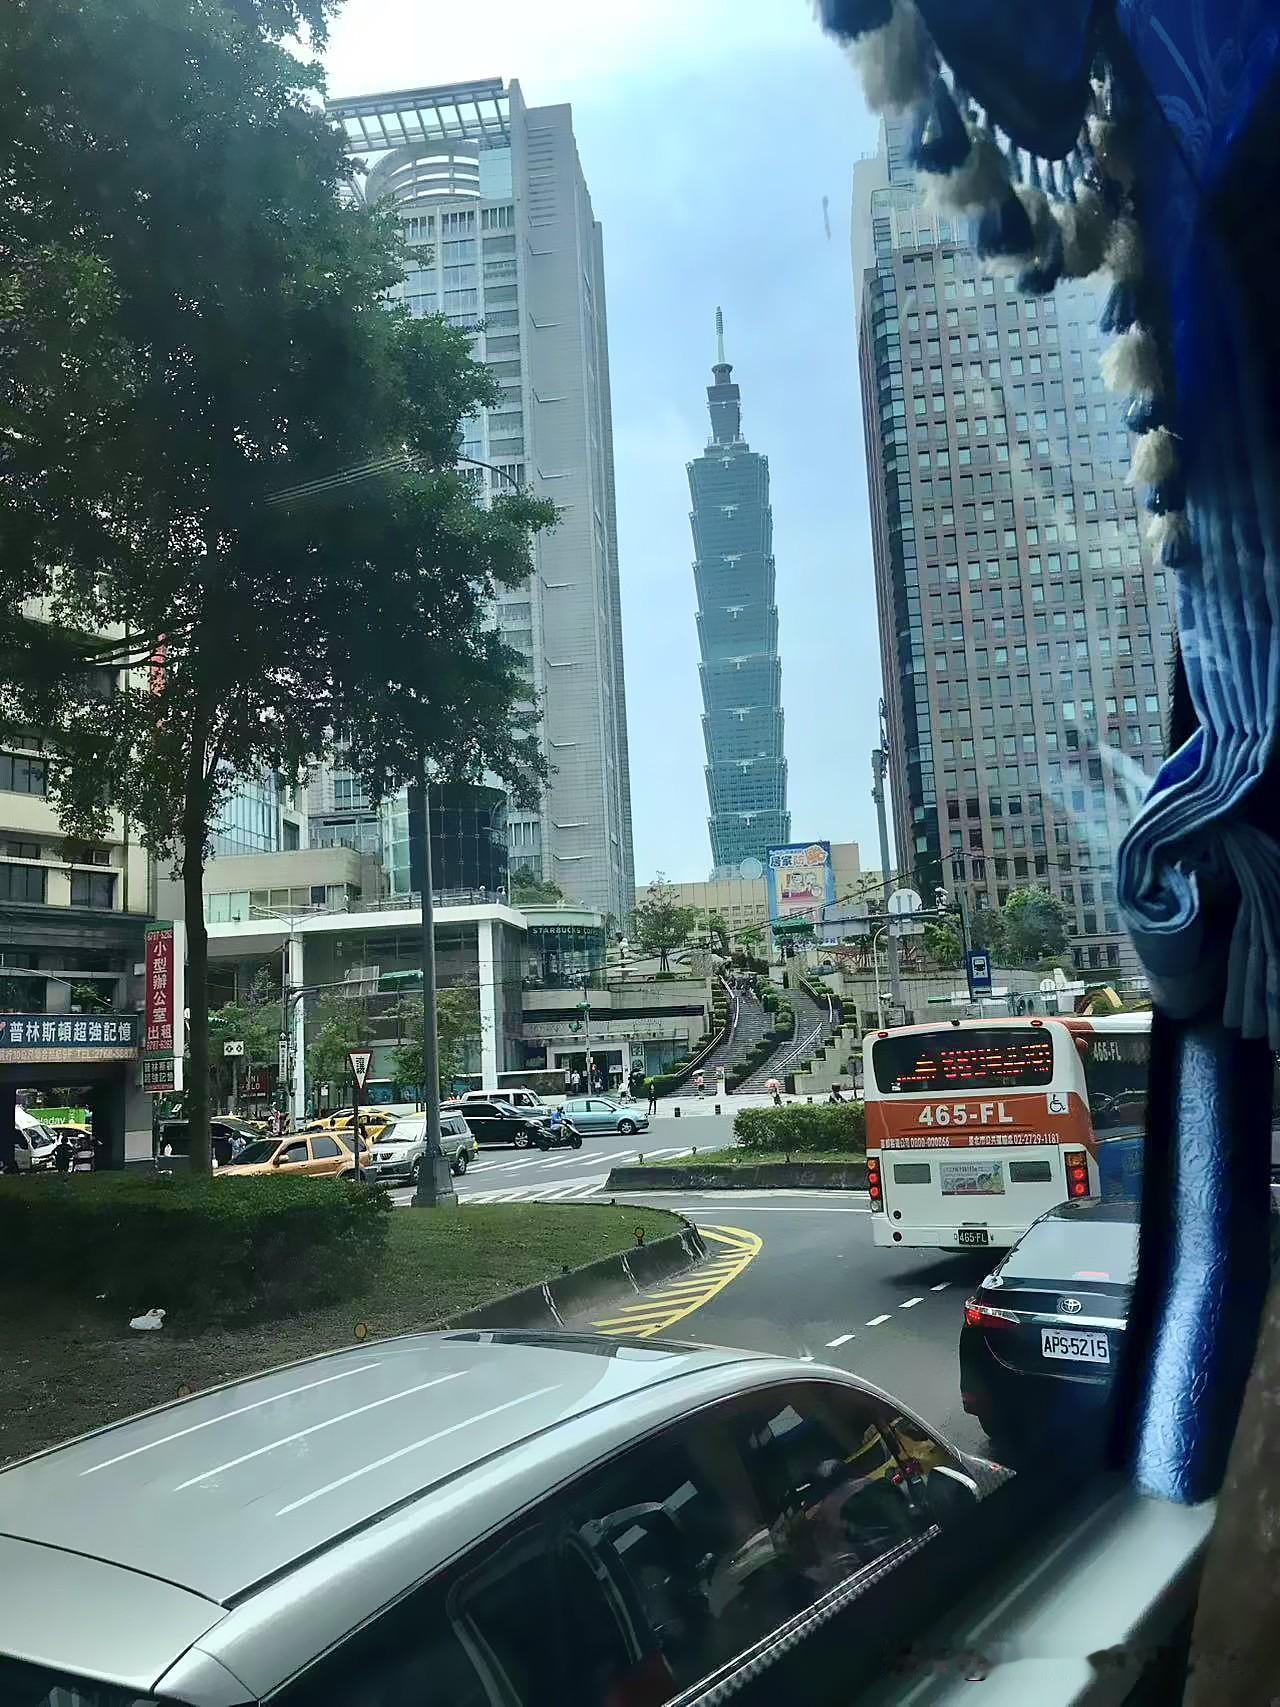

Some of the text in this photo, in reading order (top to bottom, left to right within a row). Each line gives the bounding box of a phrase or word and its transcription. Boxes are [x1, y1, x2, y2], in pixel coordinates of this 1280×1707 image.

[532, 926, 581, 935] STARBUCKS
[9, 1021, 132, 1043] 普林斯頓超強記憶
[918, 1102, 1014, 1126] 465-FL
